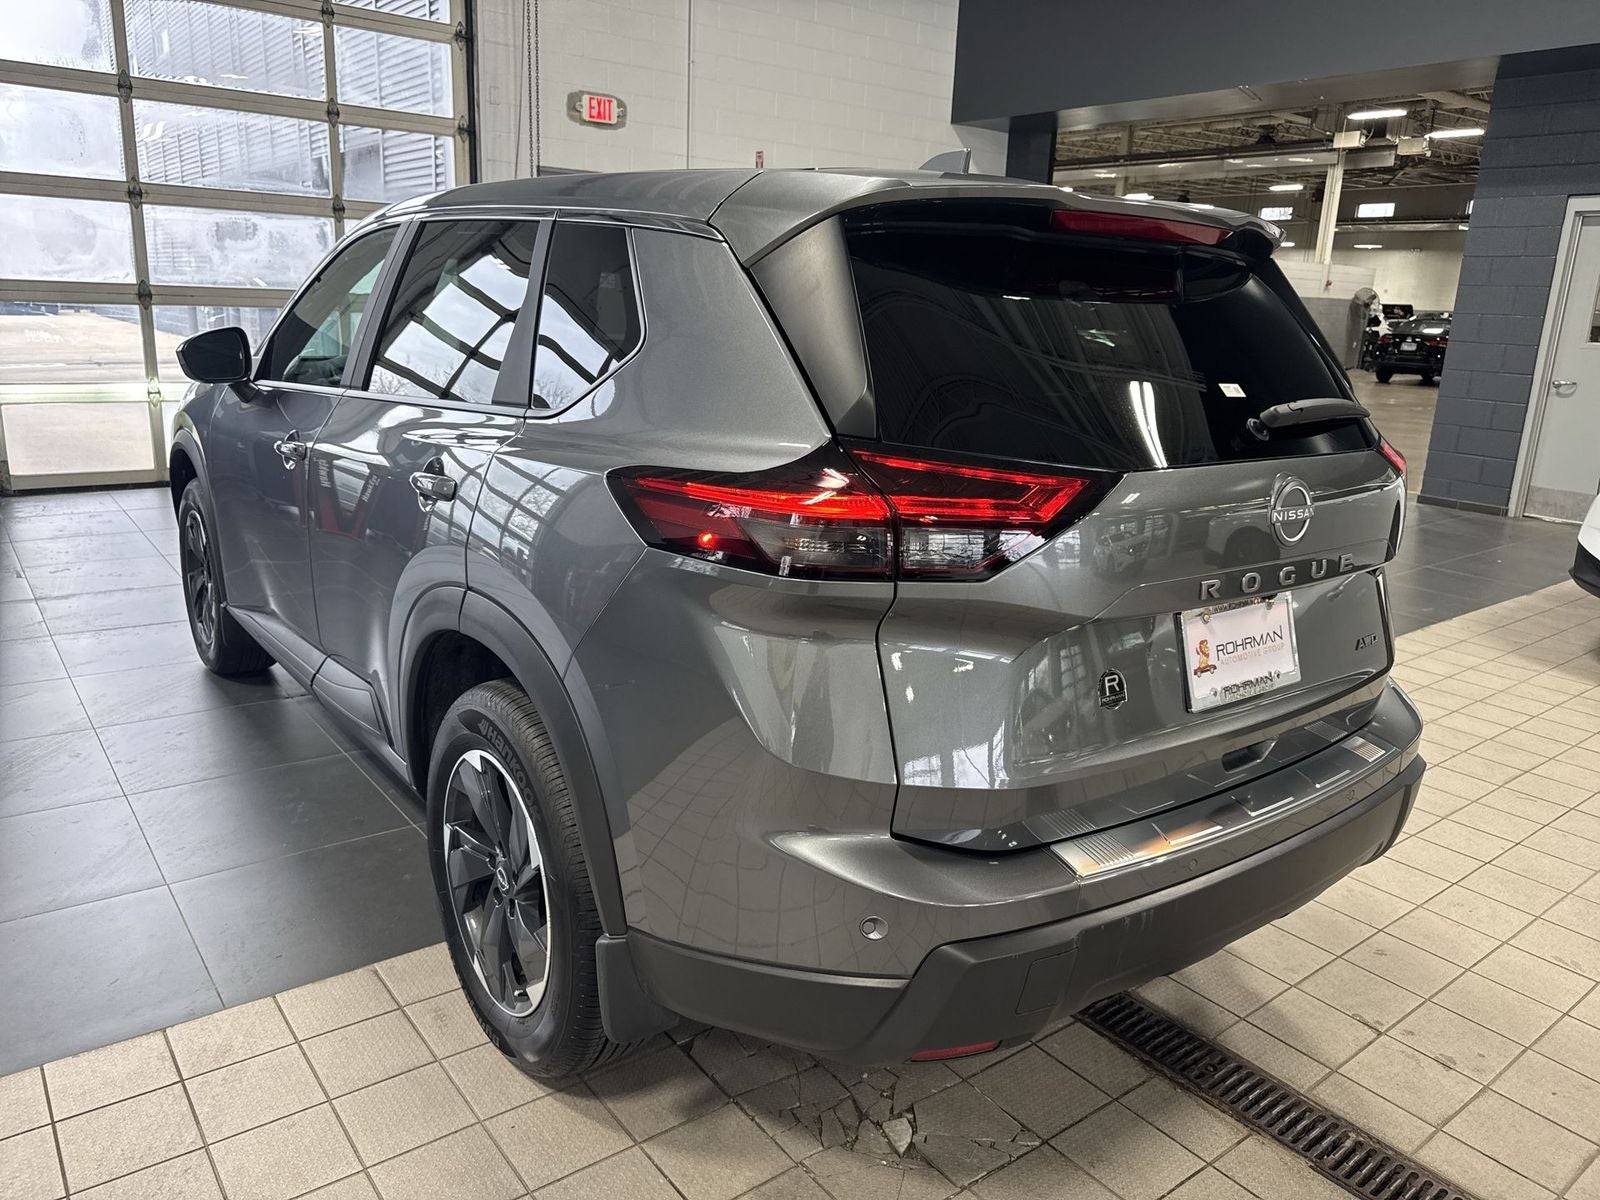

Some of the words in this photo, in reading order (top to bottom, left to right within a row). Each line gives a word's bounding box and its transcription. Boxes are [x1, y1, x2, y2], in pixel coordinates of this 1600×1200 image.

[589, 96, 613, 121] EXIT
[1200, 553, 1354, 601] ROGUE
[1215, 624, 1283, 661] ROHRMAN
[1105, 675, 1119, 696] R
[1223, 671, 1274, 699] ROHRMAN
